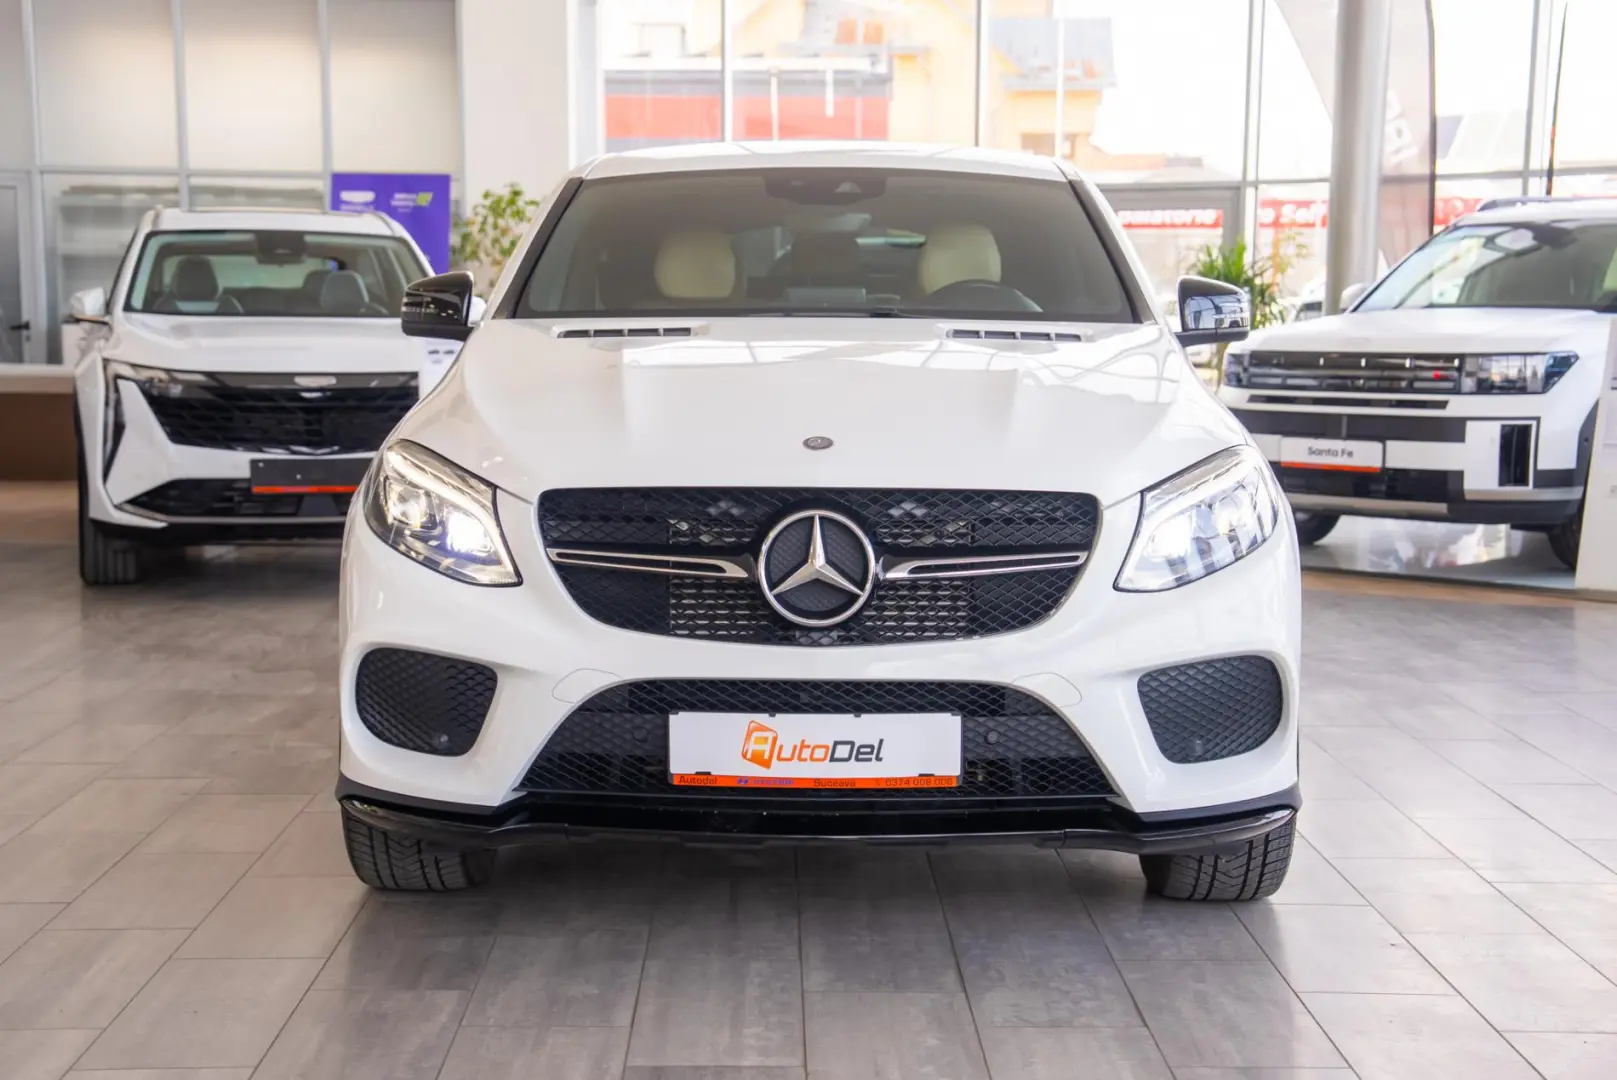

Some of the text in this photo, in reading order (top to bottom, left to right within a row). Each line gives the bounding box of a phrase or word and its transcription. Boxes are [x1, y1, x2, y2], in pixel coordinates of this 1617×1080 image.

[1307, 446, 1354, 458] Santa Fe
[743, 724, 884, 768] AutoDel
[678, 776, 719, 786] Autodel
[814, 779, 857, 788] Suceava
[885, 778, 911, 787] 0374
